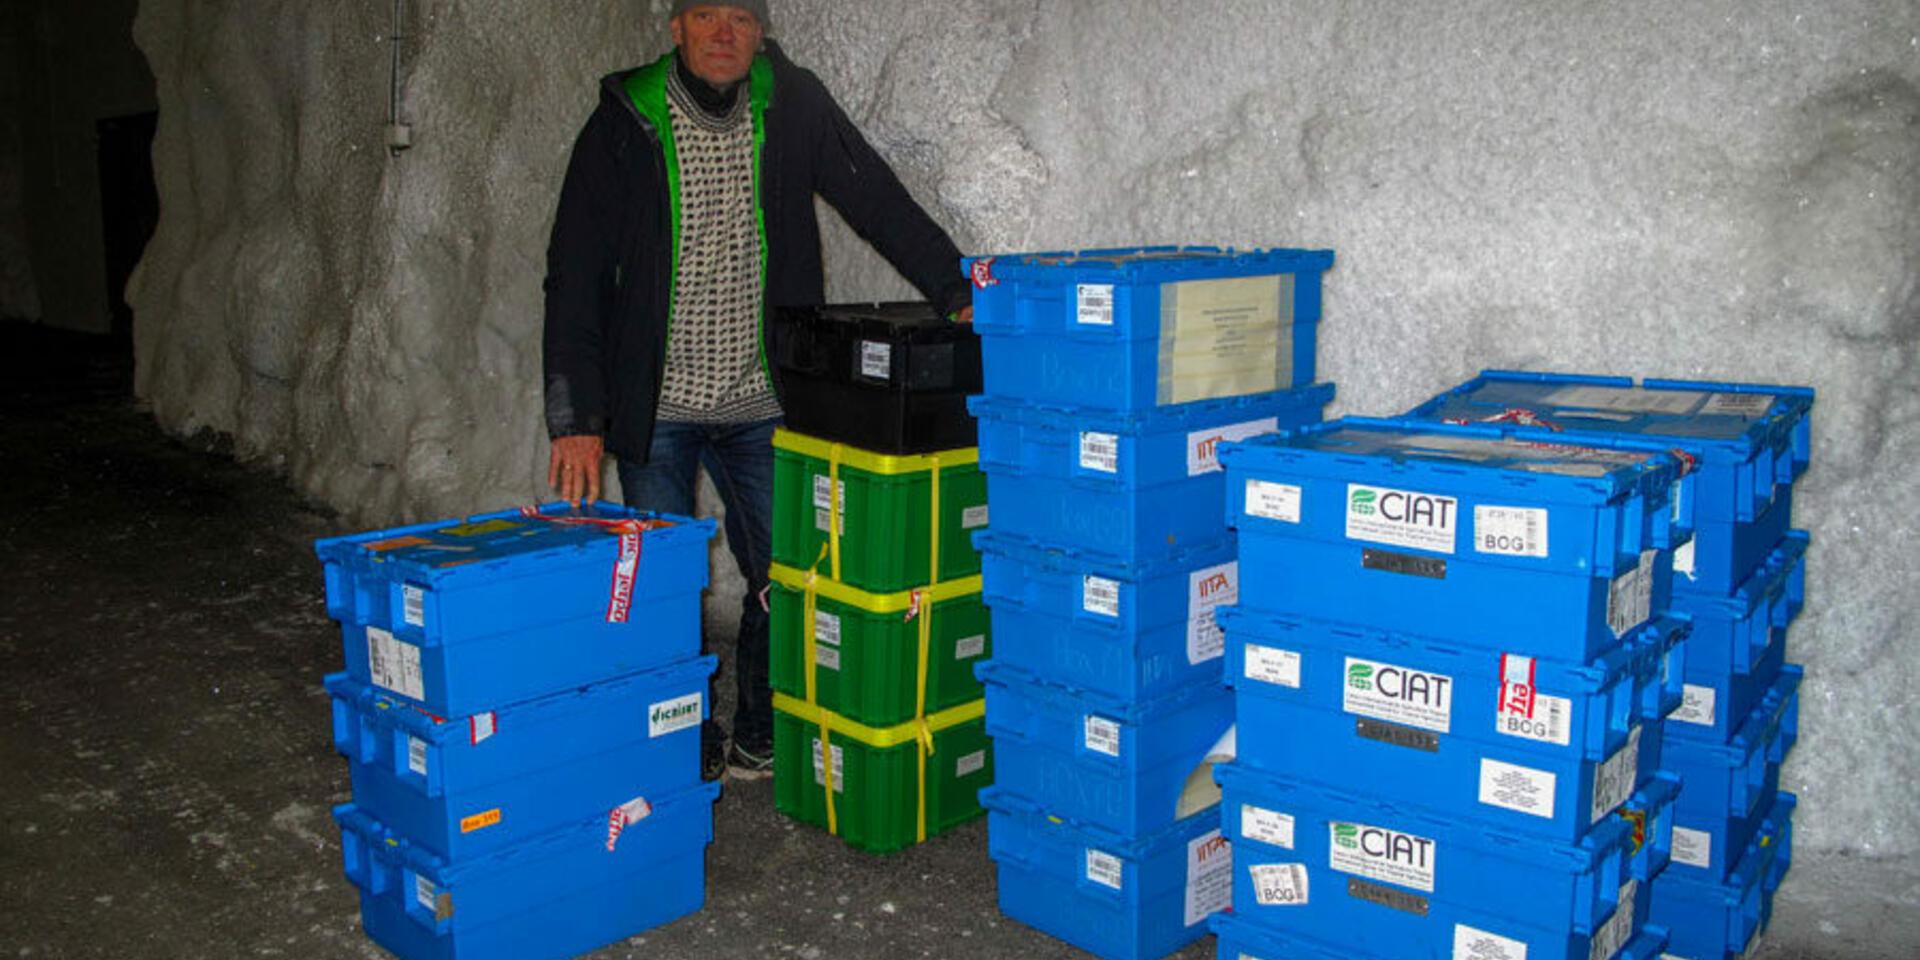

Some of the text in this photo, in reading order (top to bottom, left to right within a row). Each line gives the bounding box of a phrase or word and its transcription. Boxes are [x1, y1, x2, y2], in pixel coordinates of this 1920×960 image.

[1380, 492, 1454, 528] CIAT
[1485, 534, 1524, 552] BOG
[1199, 573, 1229, 597] IITA
[1376, 667, 1449, 707] CIAT
[1507, 717, 1546, 737] BOG
[1361, 829, 1432, 868] CIAT
[1264, 888, 1295, 902] BOG
